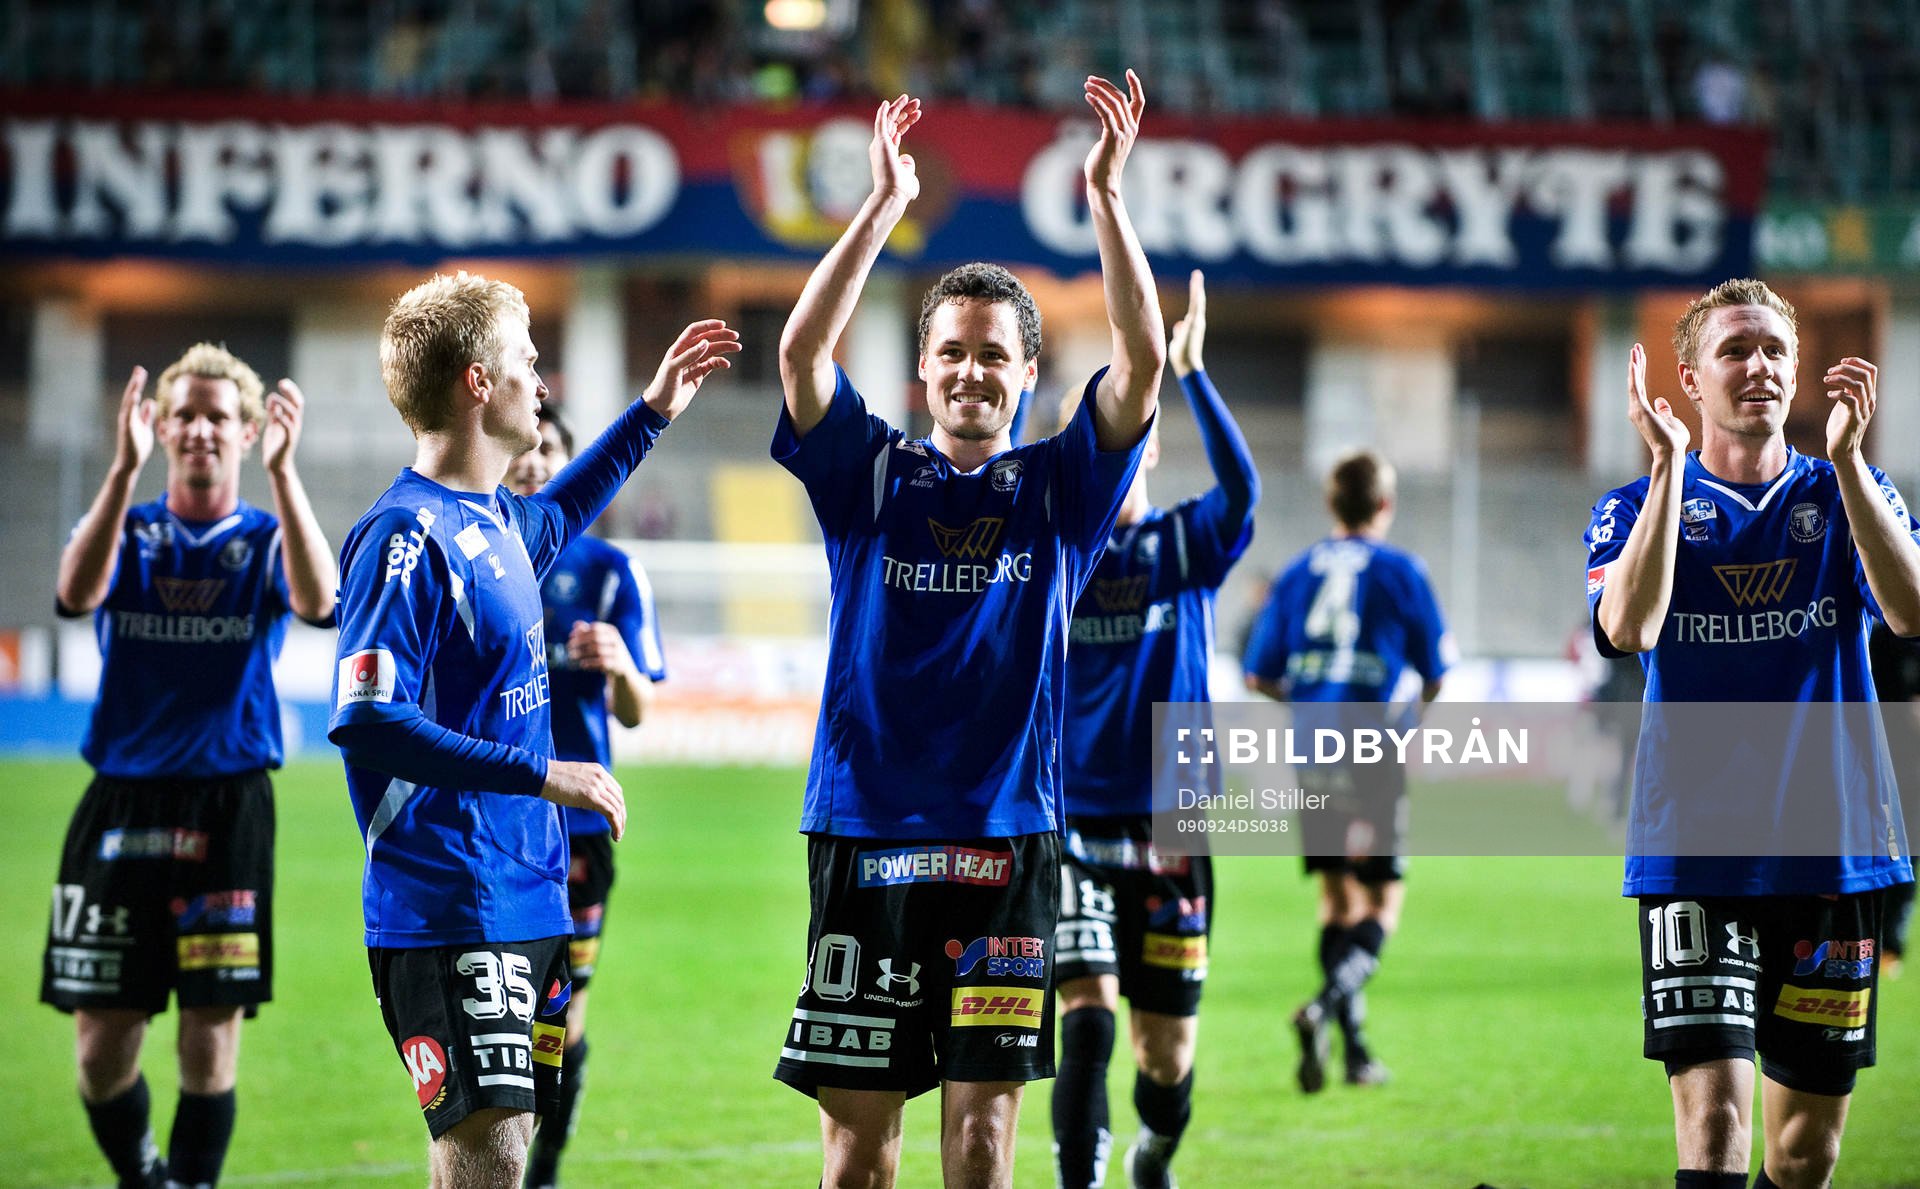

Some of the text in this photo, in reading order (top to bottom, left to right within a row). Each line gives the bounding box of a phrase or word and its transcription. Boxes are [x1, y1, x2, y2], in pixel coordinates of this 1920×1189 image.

[5, 119, 680, 241] INFERNO
[1021, 118, 1727, 275] ÖRGRYTE
[386, 533, 408, 583] TOP
[882, 552, 1032, 593] TRELLEBORG
[1673, 596, 1837, 643] TRELLEBORG
[863, 853, 1008, 881] POWER HEAT
[988, 936, 1045, 958] INTER
[1648, 901, 1709, 970] 10
[1828, 938, 1875, 960] INTER
[800, 933, 861, 1002] 0
[986, 956, 1045, 979] SPORT
[1718, 957, 1745, 967] UNDER
[456, 950, 537, 1024] 35
[863, 993, 896, 1004] UNDER
[1652, 988, 1755, 1013] TIBAB
[958, 996, 1034, 1017] DHL
[1791, 997, 1861, 1018] DHL
[793, 1021, 892, 1051] IBAB
[403, 1042, 445, 1093] XA
